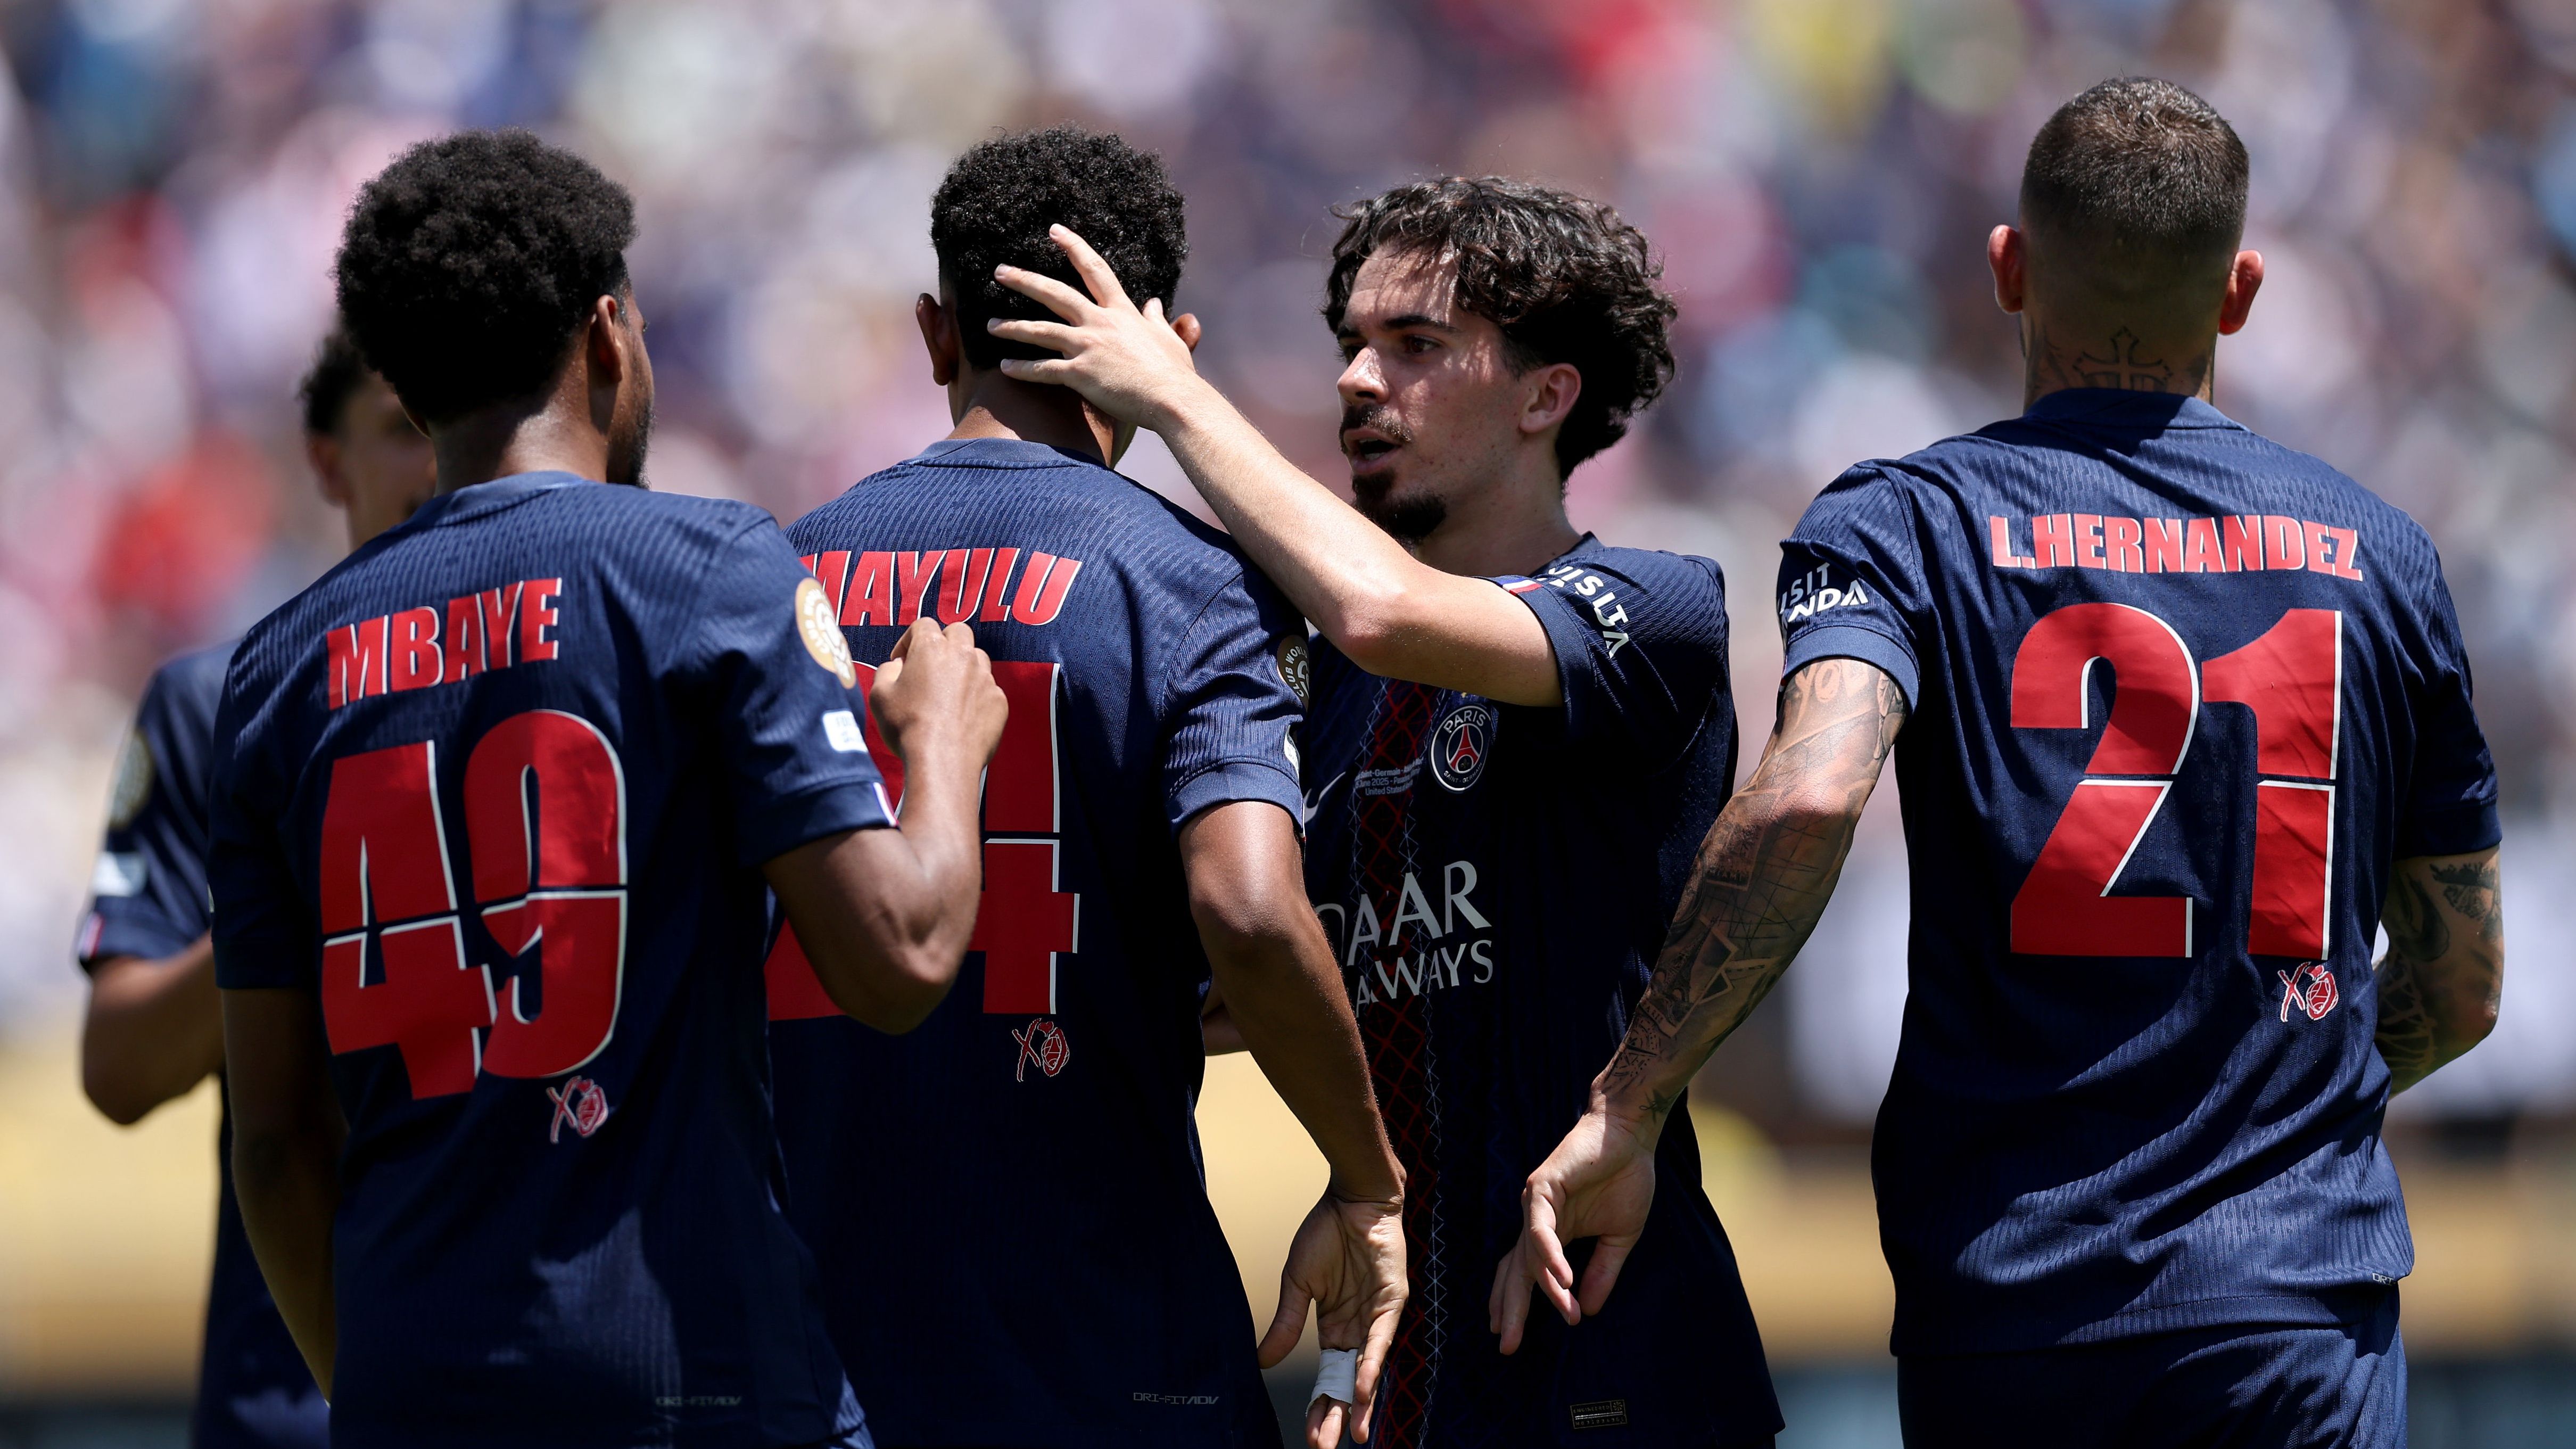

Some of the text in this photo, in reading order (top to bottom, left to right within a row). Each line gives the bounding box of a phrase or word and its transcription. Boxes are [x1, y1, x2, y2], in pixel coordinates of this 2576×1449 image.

[1989, 514, 2363, 581] L.HERNANDEZ
[1777, 562, 1830, 614] ISIT
[327, 577, 562, 710] MBAYE
[1285, 646, 1308, 697] CLUB WORLD
[1443, 710, 1486, 734] PARIS
[1372, 777, 1389, 786] 2025
[2010, 603, 2342, 960] 21
[320, 709, 628, 1100] 49
[1133, 1392, 1219, 1405] DRI-FITADV
